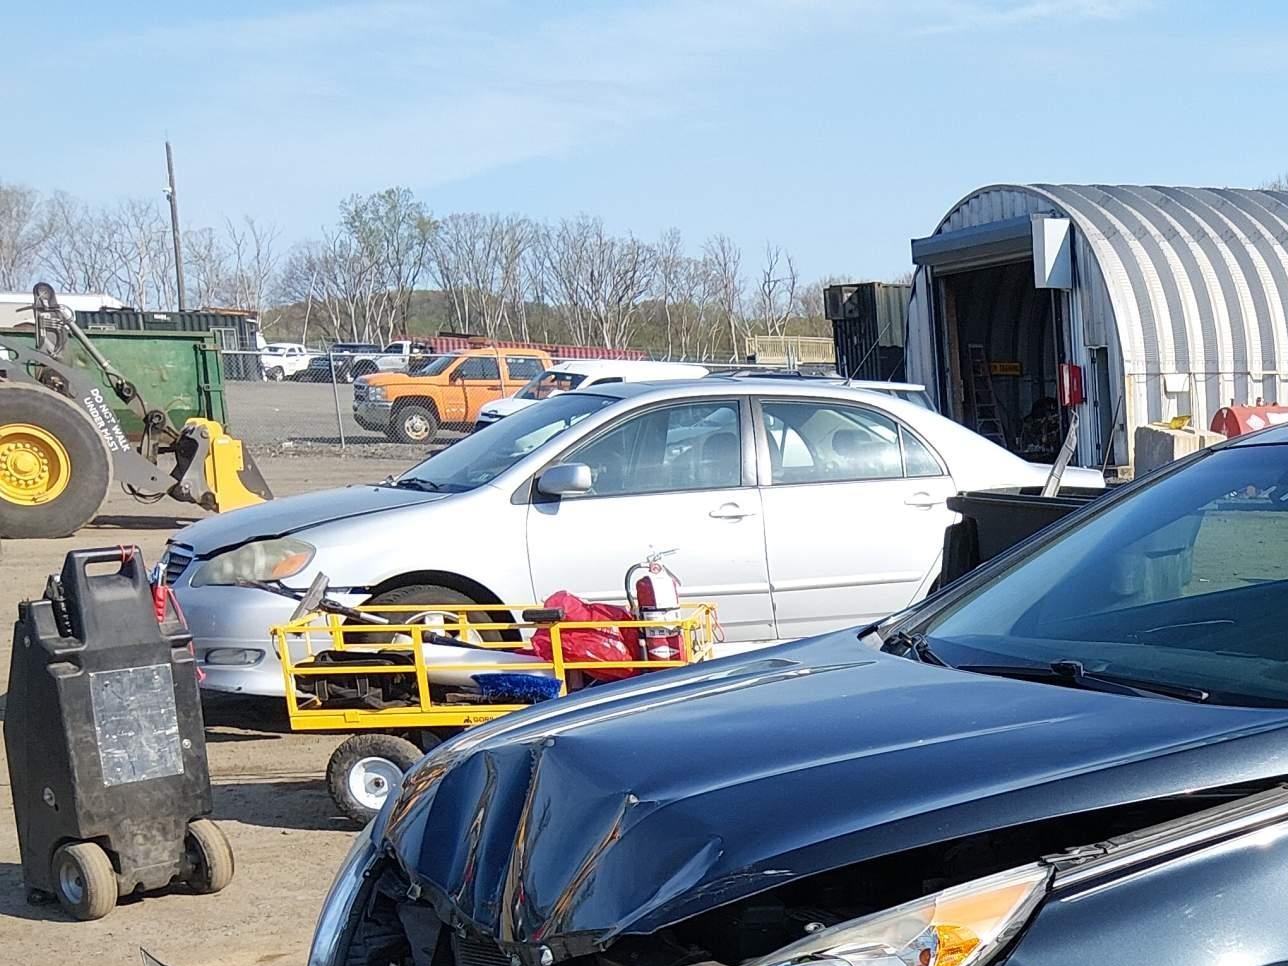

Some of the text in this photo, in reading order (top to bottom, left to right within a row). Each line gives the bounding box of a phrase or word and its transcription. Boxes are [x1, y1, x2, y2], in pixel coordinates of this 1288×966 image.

[84, 397, 119, 451] UNDER MAST
[90, 388, 131, 452] DO NOT WALK
